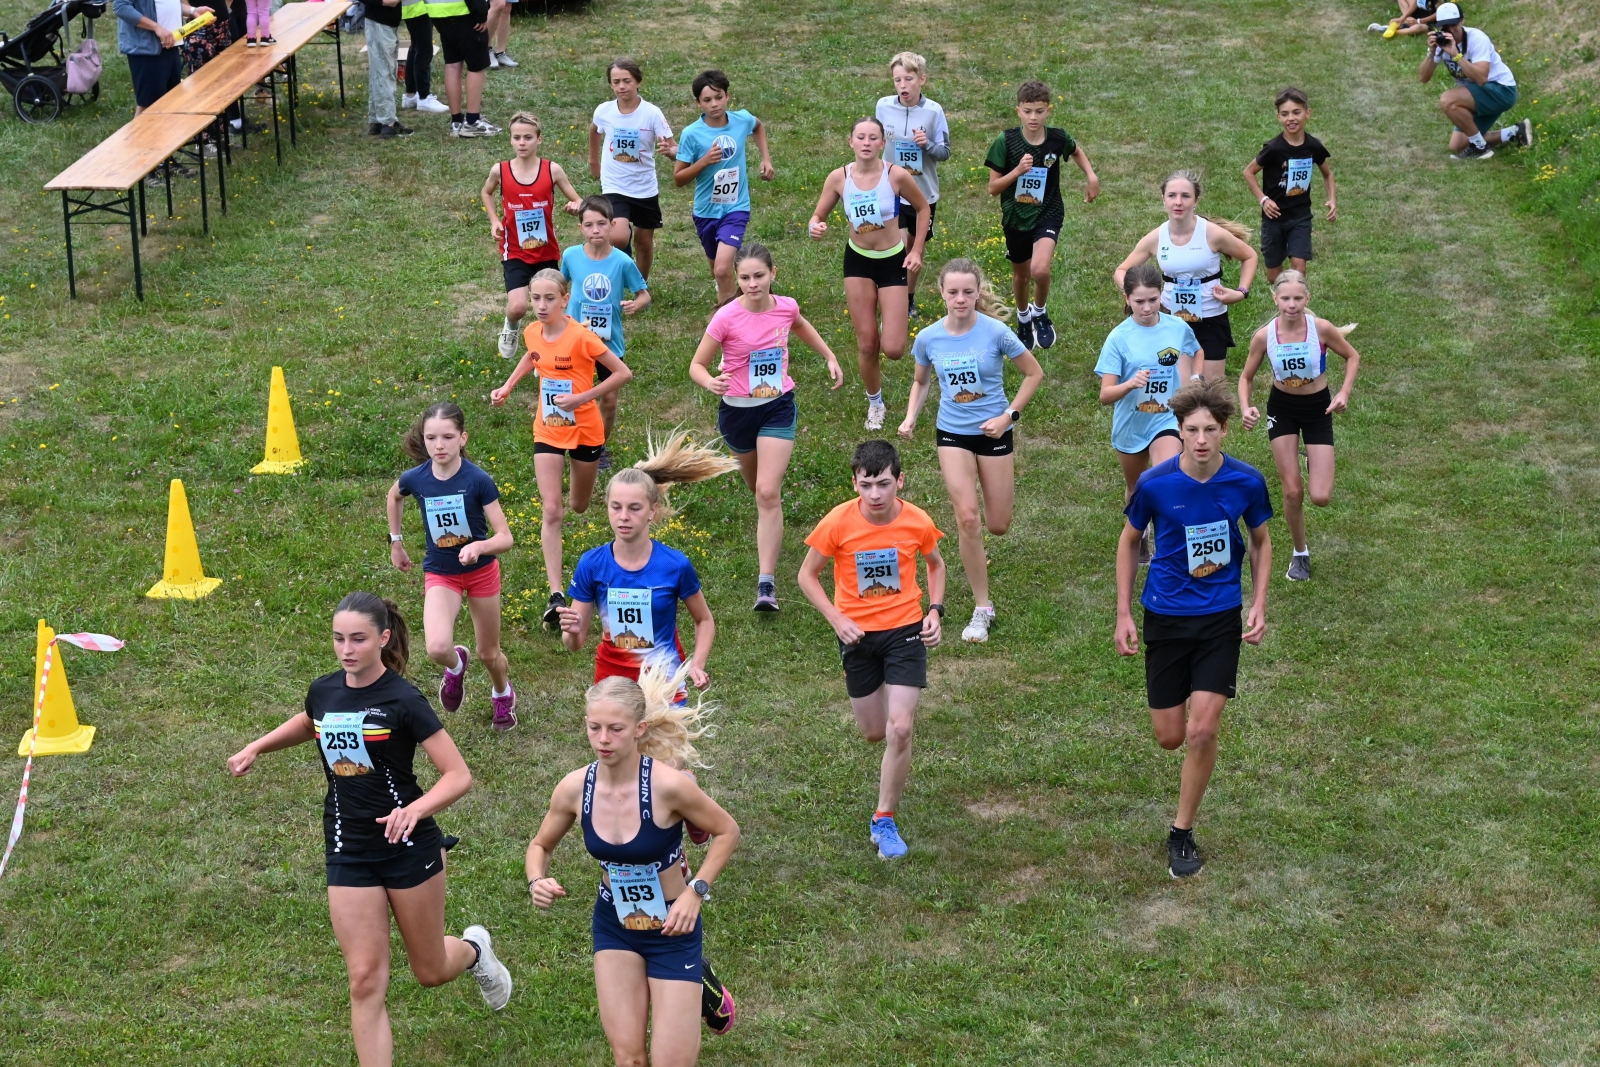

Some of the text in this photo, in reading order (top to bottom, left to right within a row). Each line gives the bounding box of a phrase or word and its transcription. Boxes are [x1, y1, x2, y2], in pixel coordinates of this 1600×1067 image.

[617, 139, 636, 149] 154
[899, 152, 918, 162] 155
[1292, 170, 1308, 182] 158
[713, 181, 739, 196] 507
[1021, 178, 1041, 190] 159
[854, 204, 876, 217] 164
[521, 220, 540, 233] 157
[1175, 292, 1197, 305] 152
[754, 362, 777, 377] 199
[1281, 357, 1306, 371] 165
[947, 371, 977, 386] 243
[1144, 380, 1168, 394] 156
[545, 393, 558, 406] 16
[436, 513, 460, 528] 151
[1191, 538, 1226, 558] 250
[863, 567, 893, 579] 251
[617, 607, 643, 624] 161
[325, 731, 360, 750] 253
[641, 768, 649, 803] NIKE
[584, 783, 593, 814] PRO
[618, 884, 655, 903] 153
